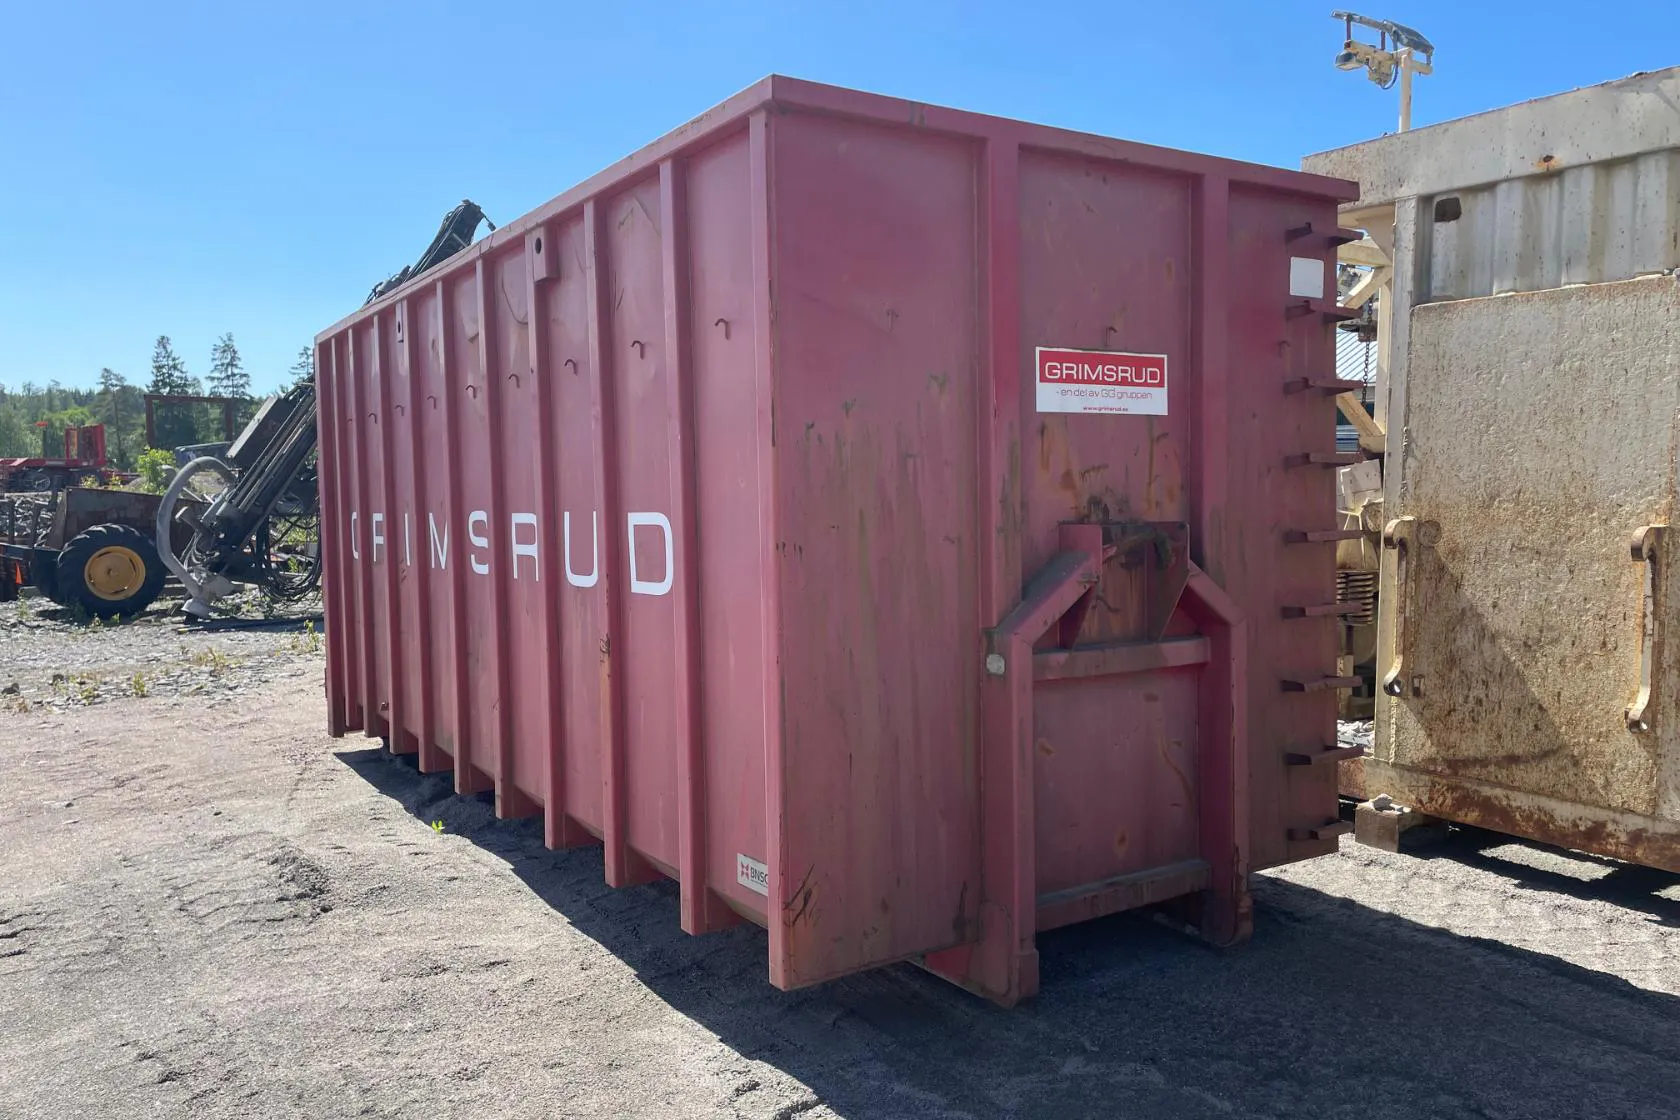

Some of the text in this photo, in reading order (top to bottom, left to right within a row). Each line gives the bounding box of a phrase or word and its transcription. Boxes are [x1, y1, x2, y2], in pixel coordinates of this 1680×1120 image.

[1045, 362, 1160, 383] GRIMSRUD
[1061, 389, 1073, 397] en
[1074, 388, 1087, 397] del
[1117, 390, 1153, 400] gruppen
